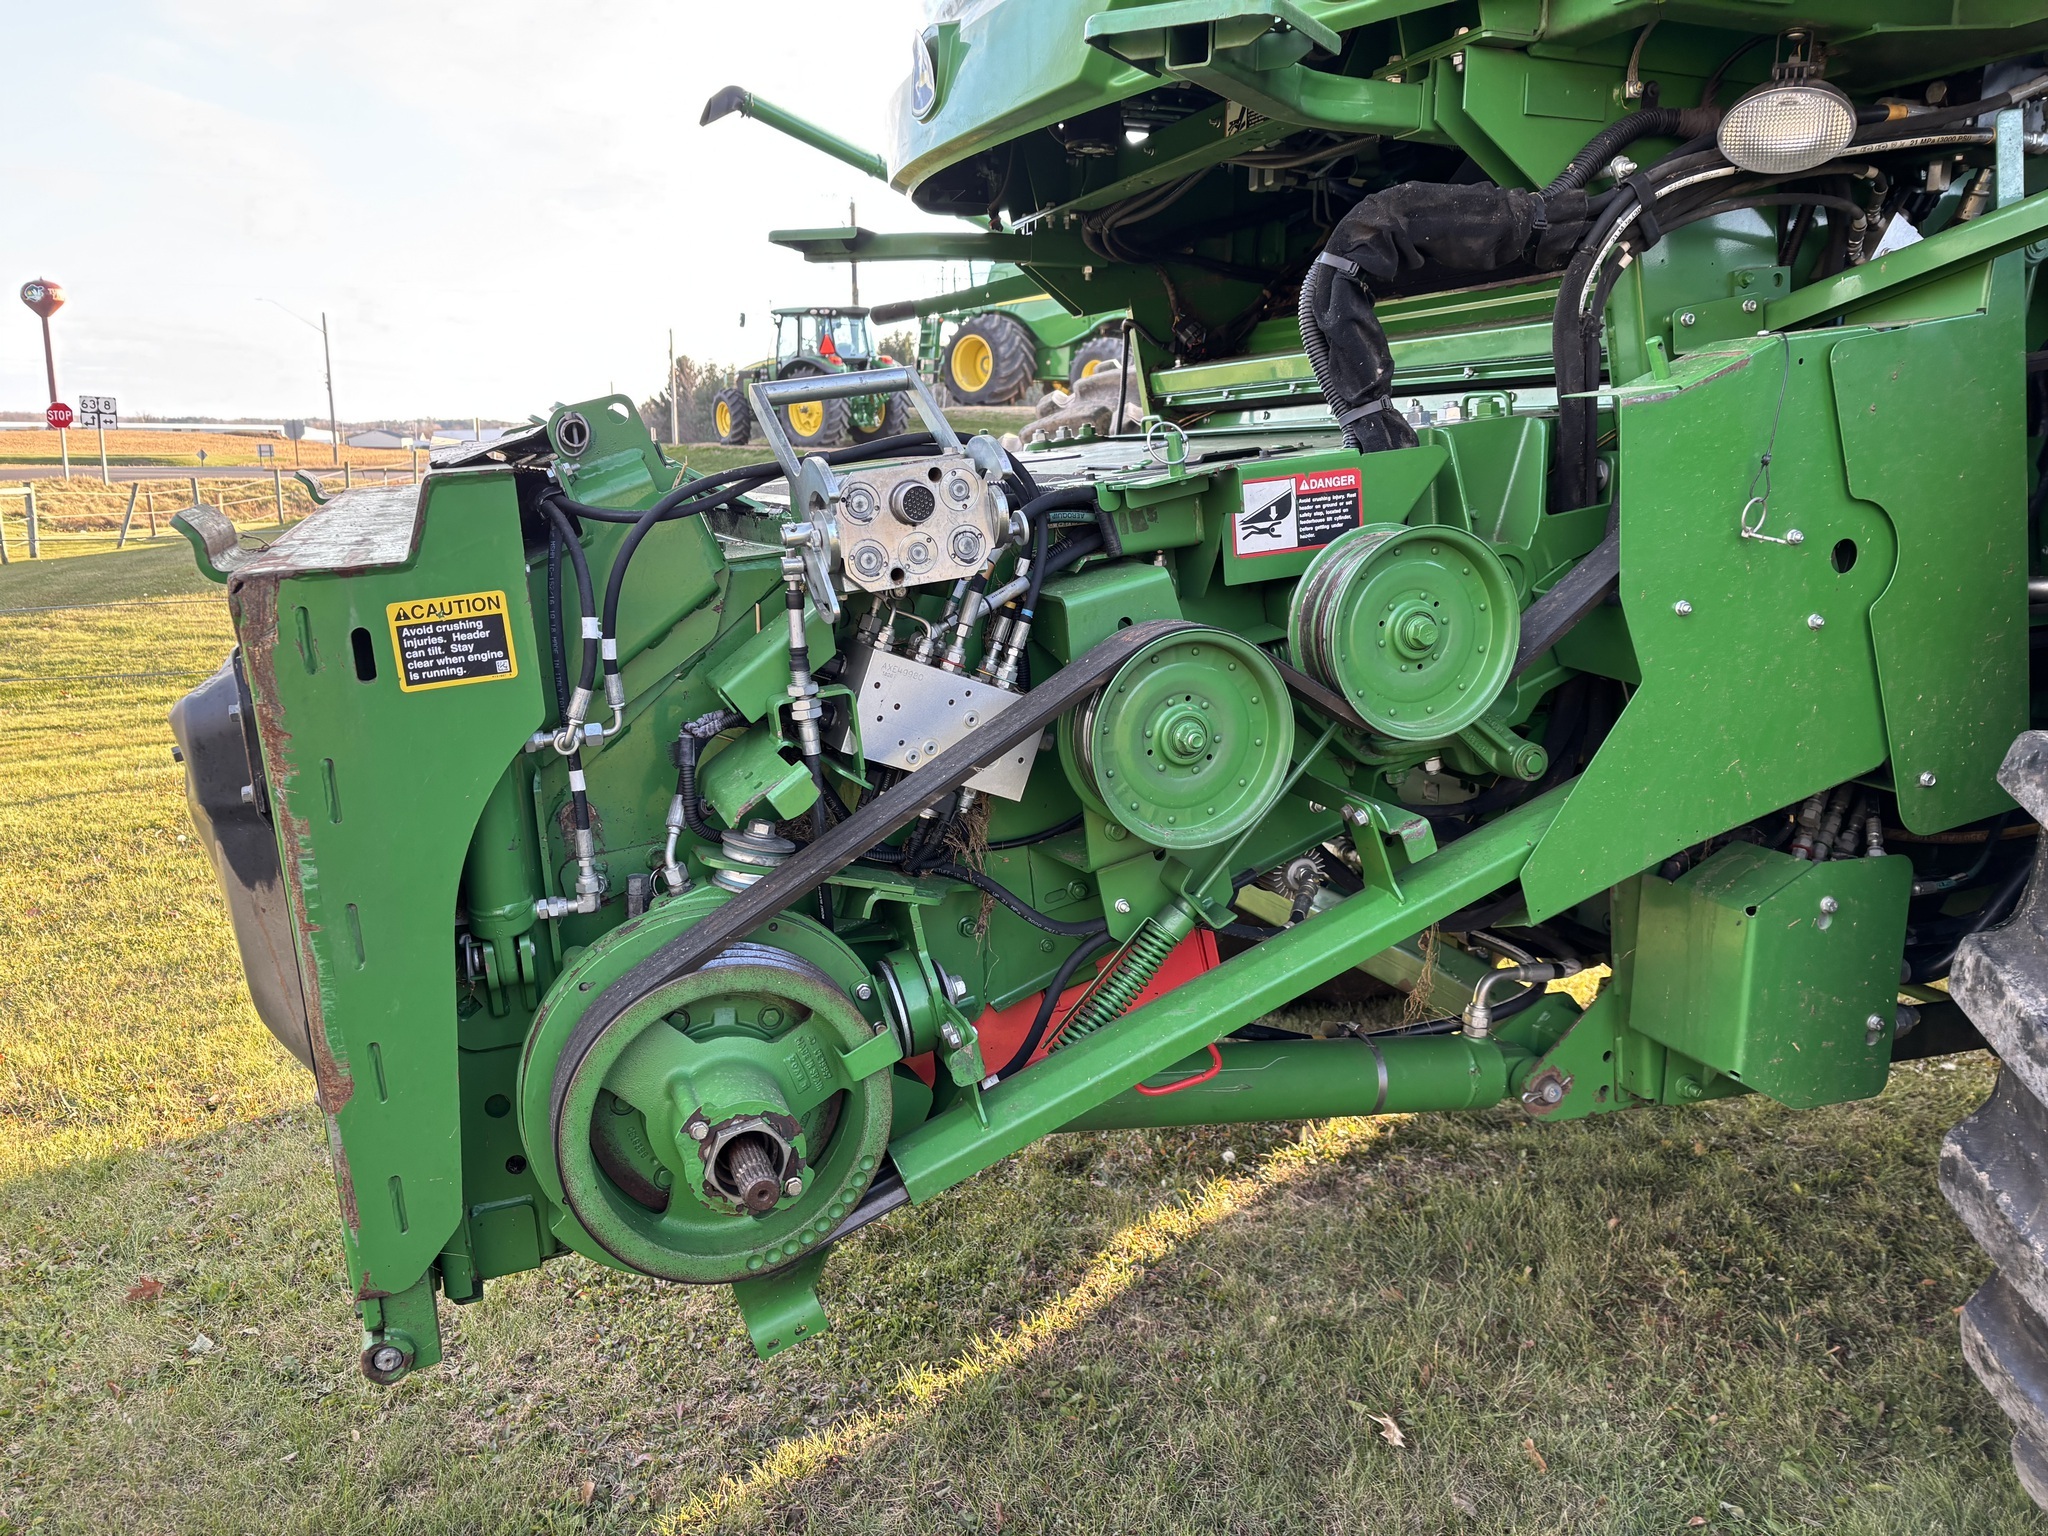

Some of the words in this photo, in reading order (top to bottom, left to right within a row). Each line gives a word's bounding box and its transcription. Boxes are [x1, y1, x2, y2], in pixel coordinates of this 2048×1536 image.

[81, 399, 96, 409] 63
[103, 400, 111, 410] 8
[47, 410, 72, 421] STOP
[1309, 475, 1355, 490] DANGER
[410, 595, 501, 619] CAUTION
[402, 624, 434, 638] Avoid
[435, 620, 484, 633] crushing
[403, 635, 447, 649] injuries.
[452, 630, 491, 642] Header
[551, 636, 559, 654] MADE
[405, 650, 426, 659] can
[427, 646, 446, 656] tilt.
[450, 643, 475, 654] Stay
[407, 659, 434, 670] clear
[436, 655, 466, 666] when
[467, 650, 504, 663] engine
[553, 659, 560, 669] IN
[409, 671, 420, 681] is
[421, 666, 467, 679] running.
[555, 673, 563, 693] ITALY
